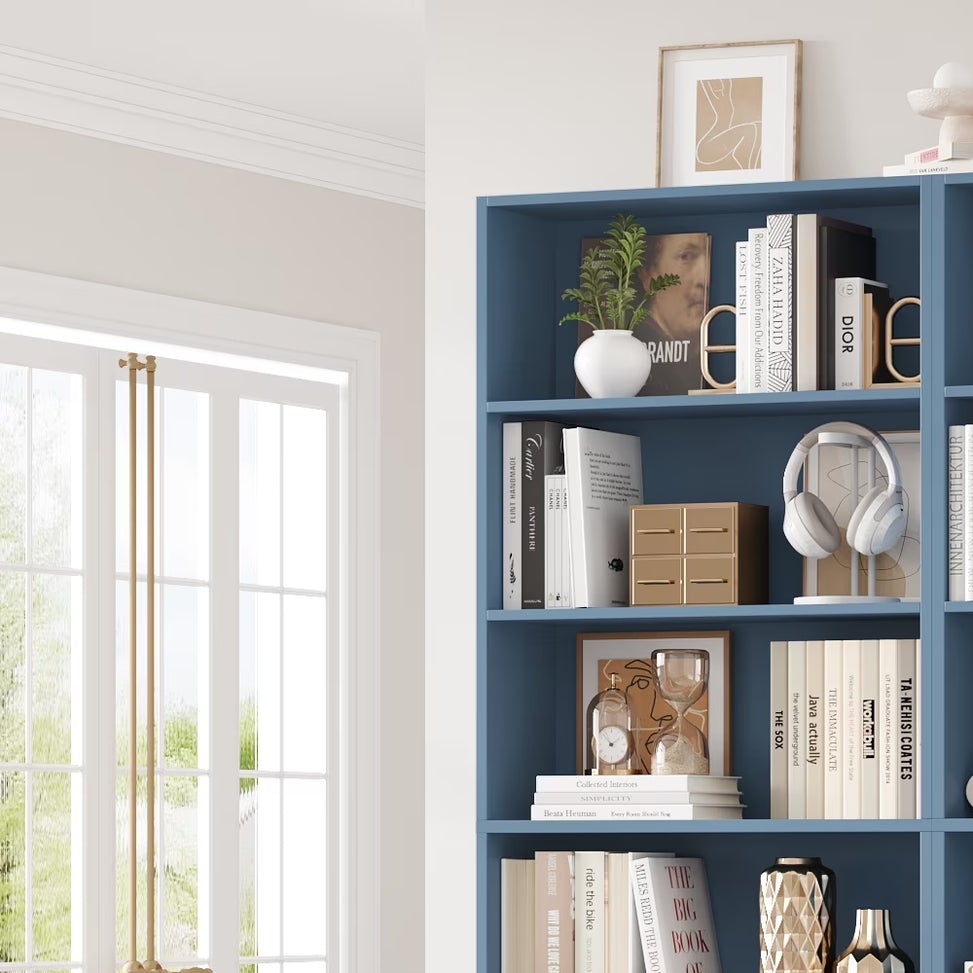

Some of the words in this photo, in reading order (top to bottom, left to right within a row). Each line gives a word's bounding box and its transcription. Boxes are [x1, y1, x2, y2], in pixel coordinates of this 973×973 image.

[772, 257, 784, 294] ZAHA
[772, 299, 784, 345] HADID
[841, 316, 854, 354] DIOR
[526, 433, 542, 480] Cartier
[950, 435, 964, 576] INNENARCHITEKTUR
[808, 694, 820, 718] Java
[828, 688, 837, 706] THE
[900, 678, 913, 734] TA-NEHISI
[774, 710, 784, 727] THE
[774, 730, 784, 750] SOX
[806, 723, 820, 768] actually
[900, 736, 913, 780] COATES
[585, 868, 596, 888] ride
[664, 865, 694, 890] THE
[585, 890, 596, 907] the
[672, 898, 697, 922] BIG
[585, 909, 596, 931] bike
[671, 929, 710, 954] BOOK
